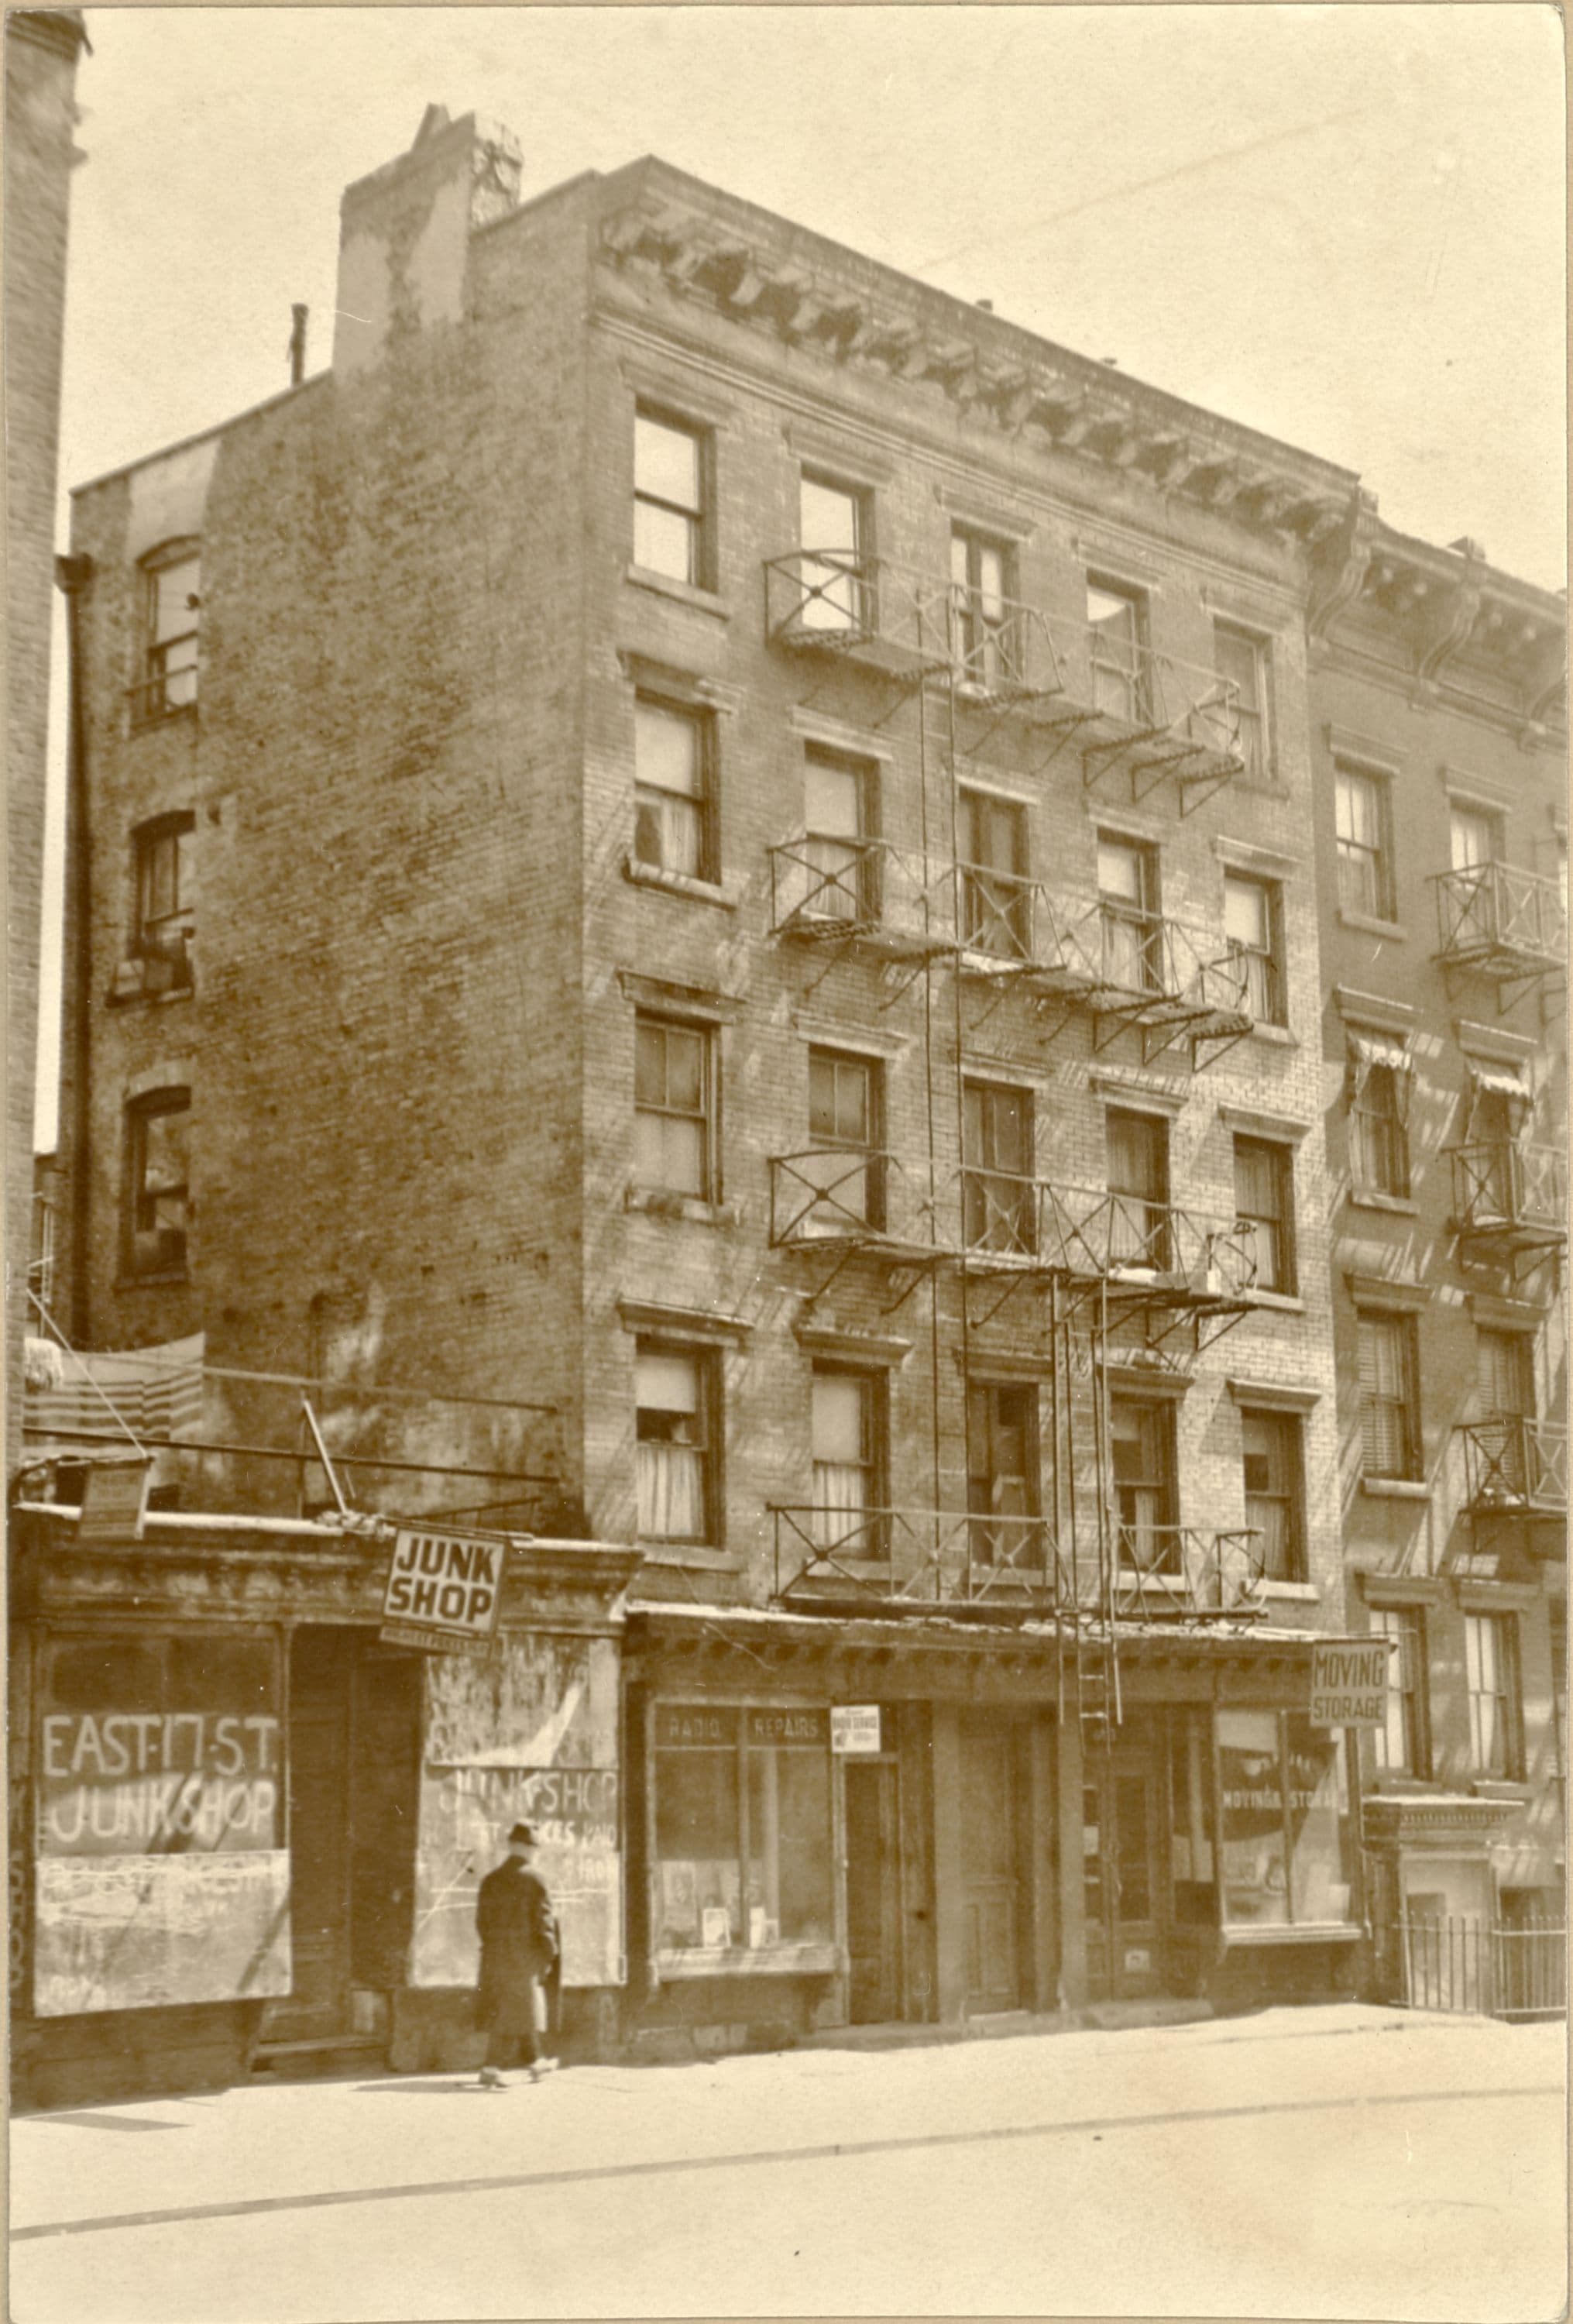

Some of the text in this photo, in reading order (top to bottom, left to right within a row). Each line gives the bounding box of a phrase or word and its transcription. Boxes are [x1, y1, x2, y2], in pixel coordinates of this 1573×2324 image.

[397, 1537, 494, 1585] JUNK
[390, 1576, 492, 1623] SHOP
[1314, 1650, 1384, 1687] MOVING
[754, 1717, 819, 1737] REPAIRS
[1314, 1696, 1383, 1719] STORAGE
[50, 1776, 178, 1842] JUNK
[172, 1773, 274, 1835] SHOP
[542, 1772, 617, 1813] SHOP
